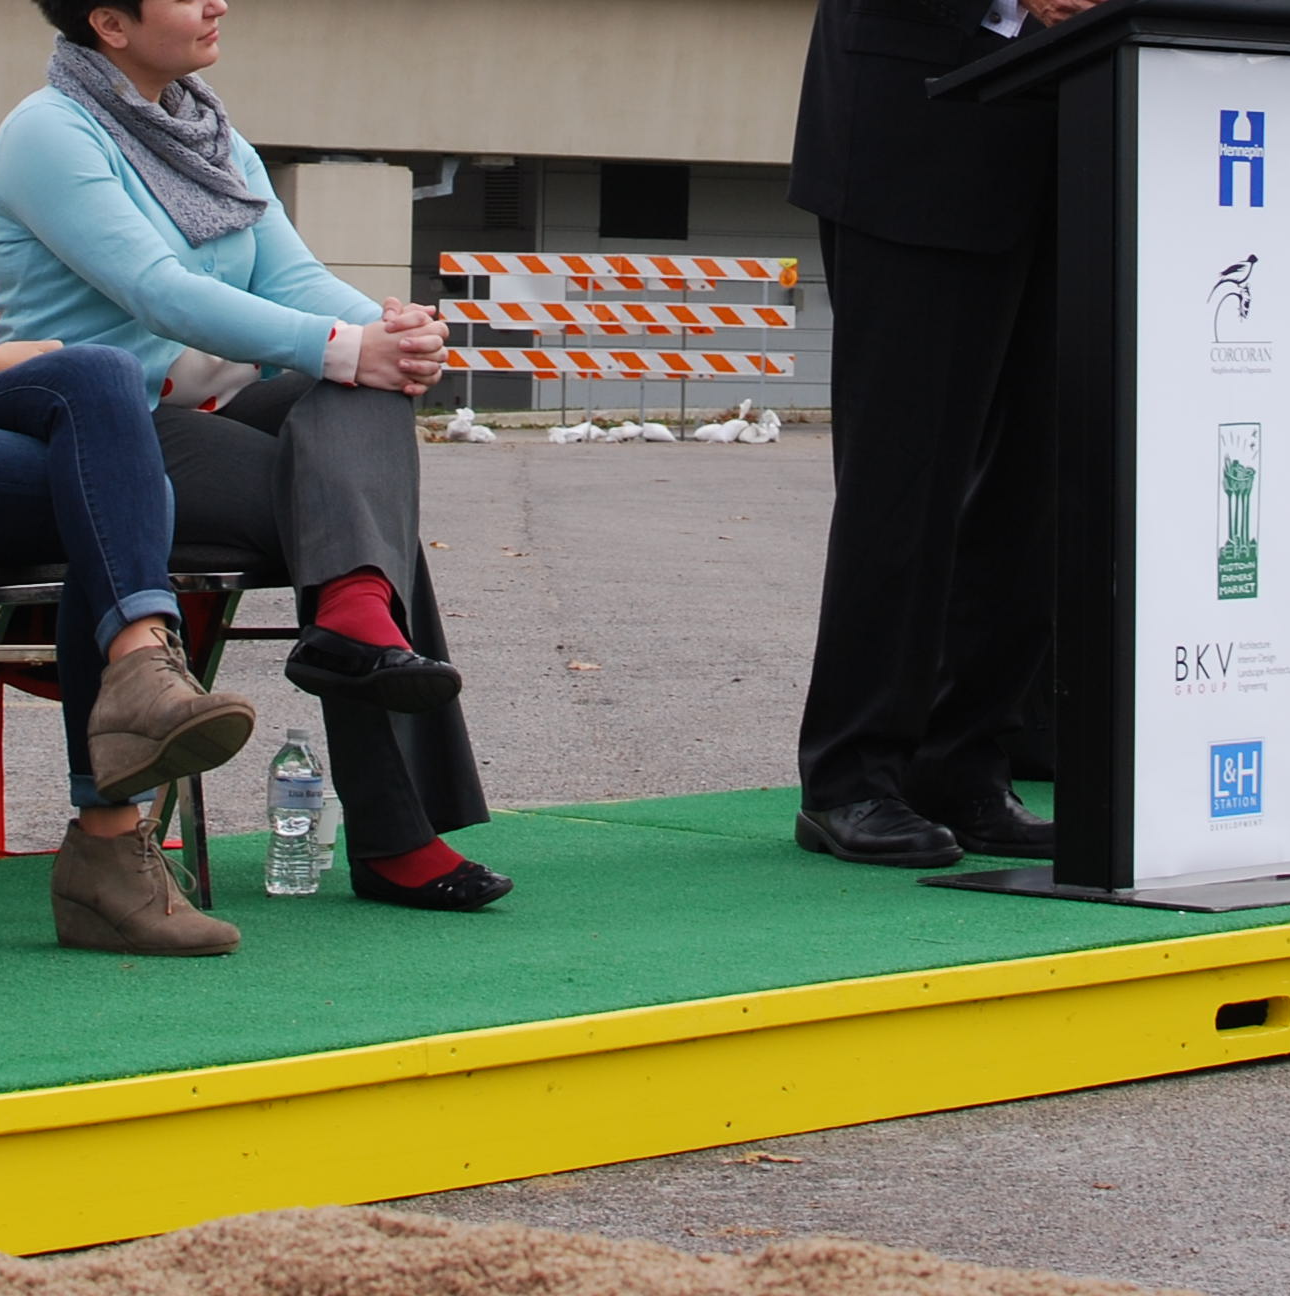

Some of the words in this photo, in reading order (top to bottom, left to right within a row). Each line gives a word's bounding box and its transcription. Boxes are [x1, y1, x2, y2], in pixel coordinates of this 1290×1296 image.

[1210, 347, 1272, 362] CORCORAN
[1219, 561, 1256, 572] MIDTOWN
[1219, 582, 1256, 595] MARKET
[1174, 681, 1228, 696] GROUP
[1214, 750, 1259, 798] L&H
[1213, 795, 1257, 810] STATION
